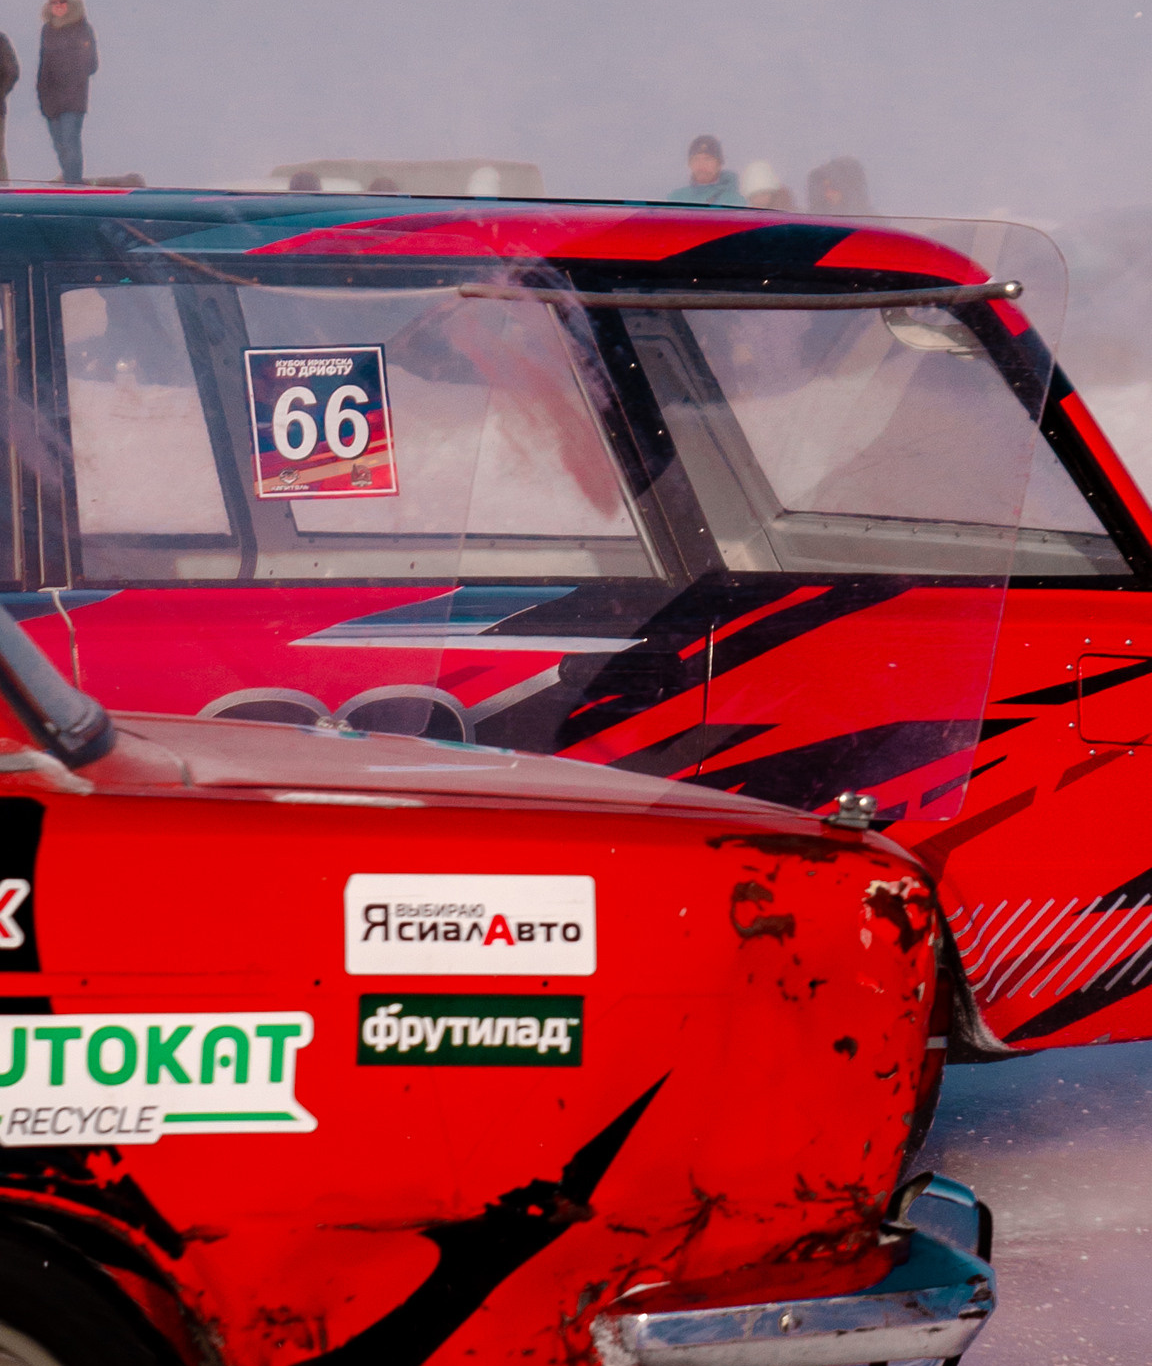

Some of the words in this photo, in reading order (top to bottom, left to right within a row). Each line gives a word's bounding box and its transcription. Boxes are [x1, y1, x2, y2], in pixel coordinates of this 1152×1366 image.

[276, 366, 297, 378] ПО
[297, 365, 353, 378] ДРИФТУ
[272, 384, 370, 461] 66
[394, 903, 485, 918] ВЫБИРАЮ
[5, 1104, 159, 1135] RECYCLE
